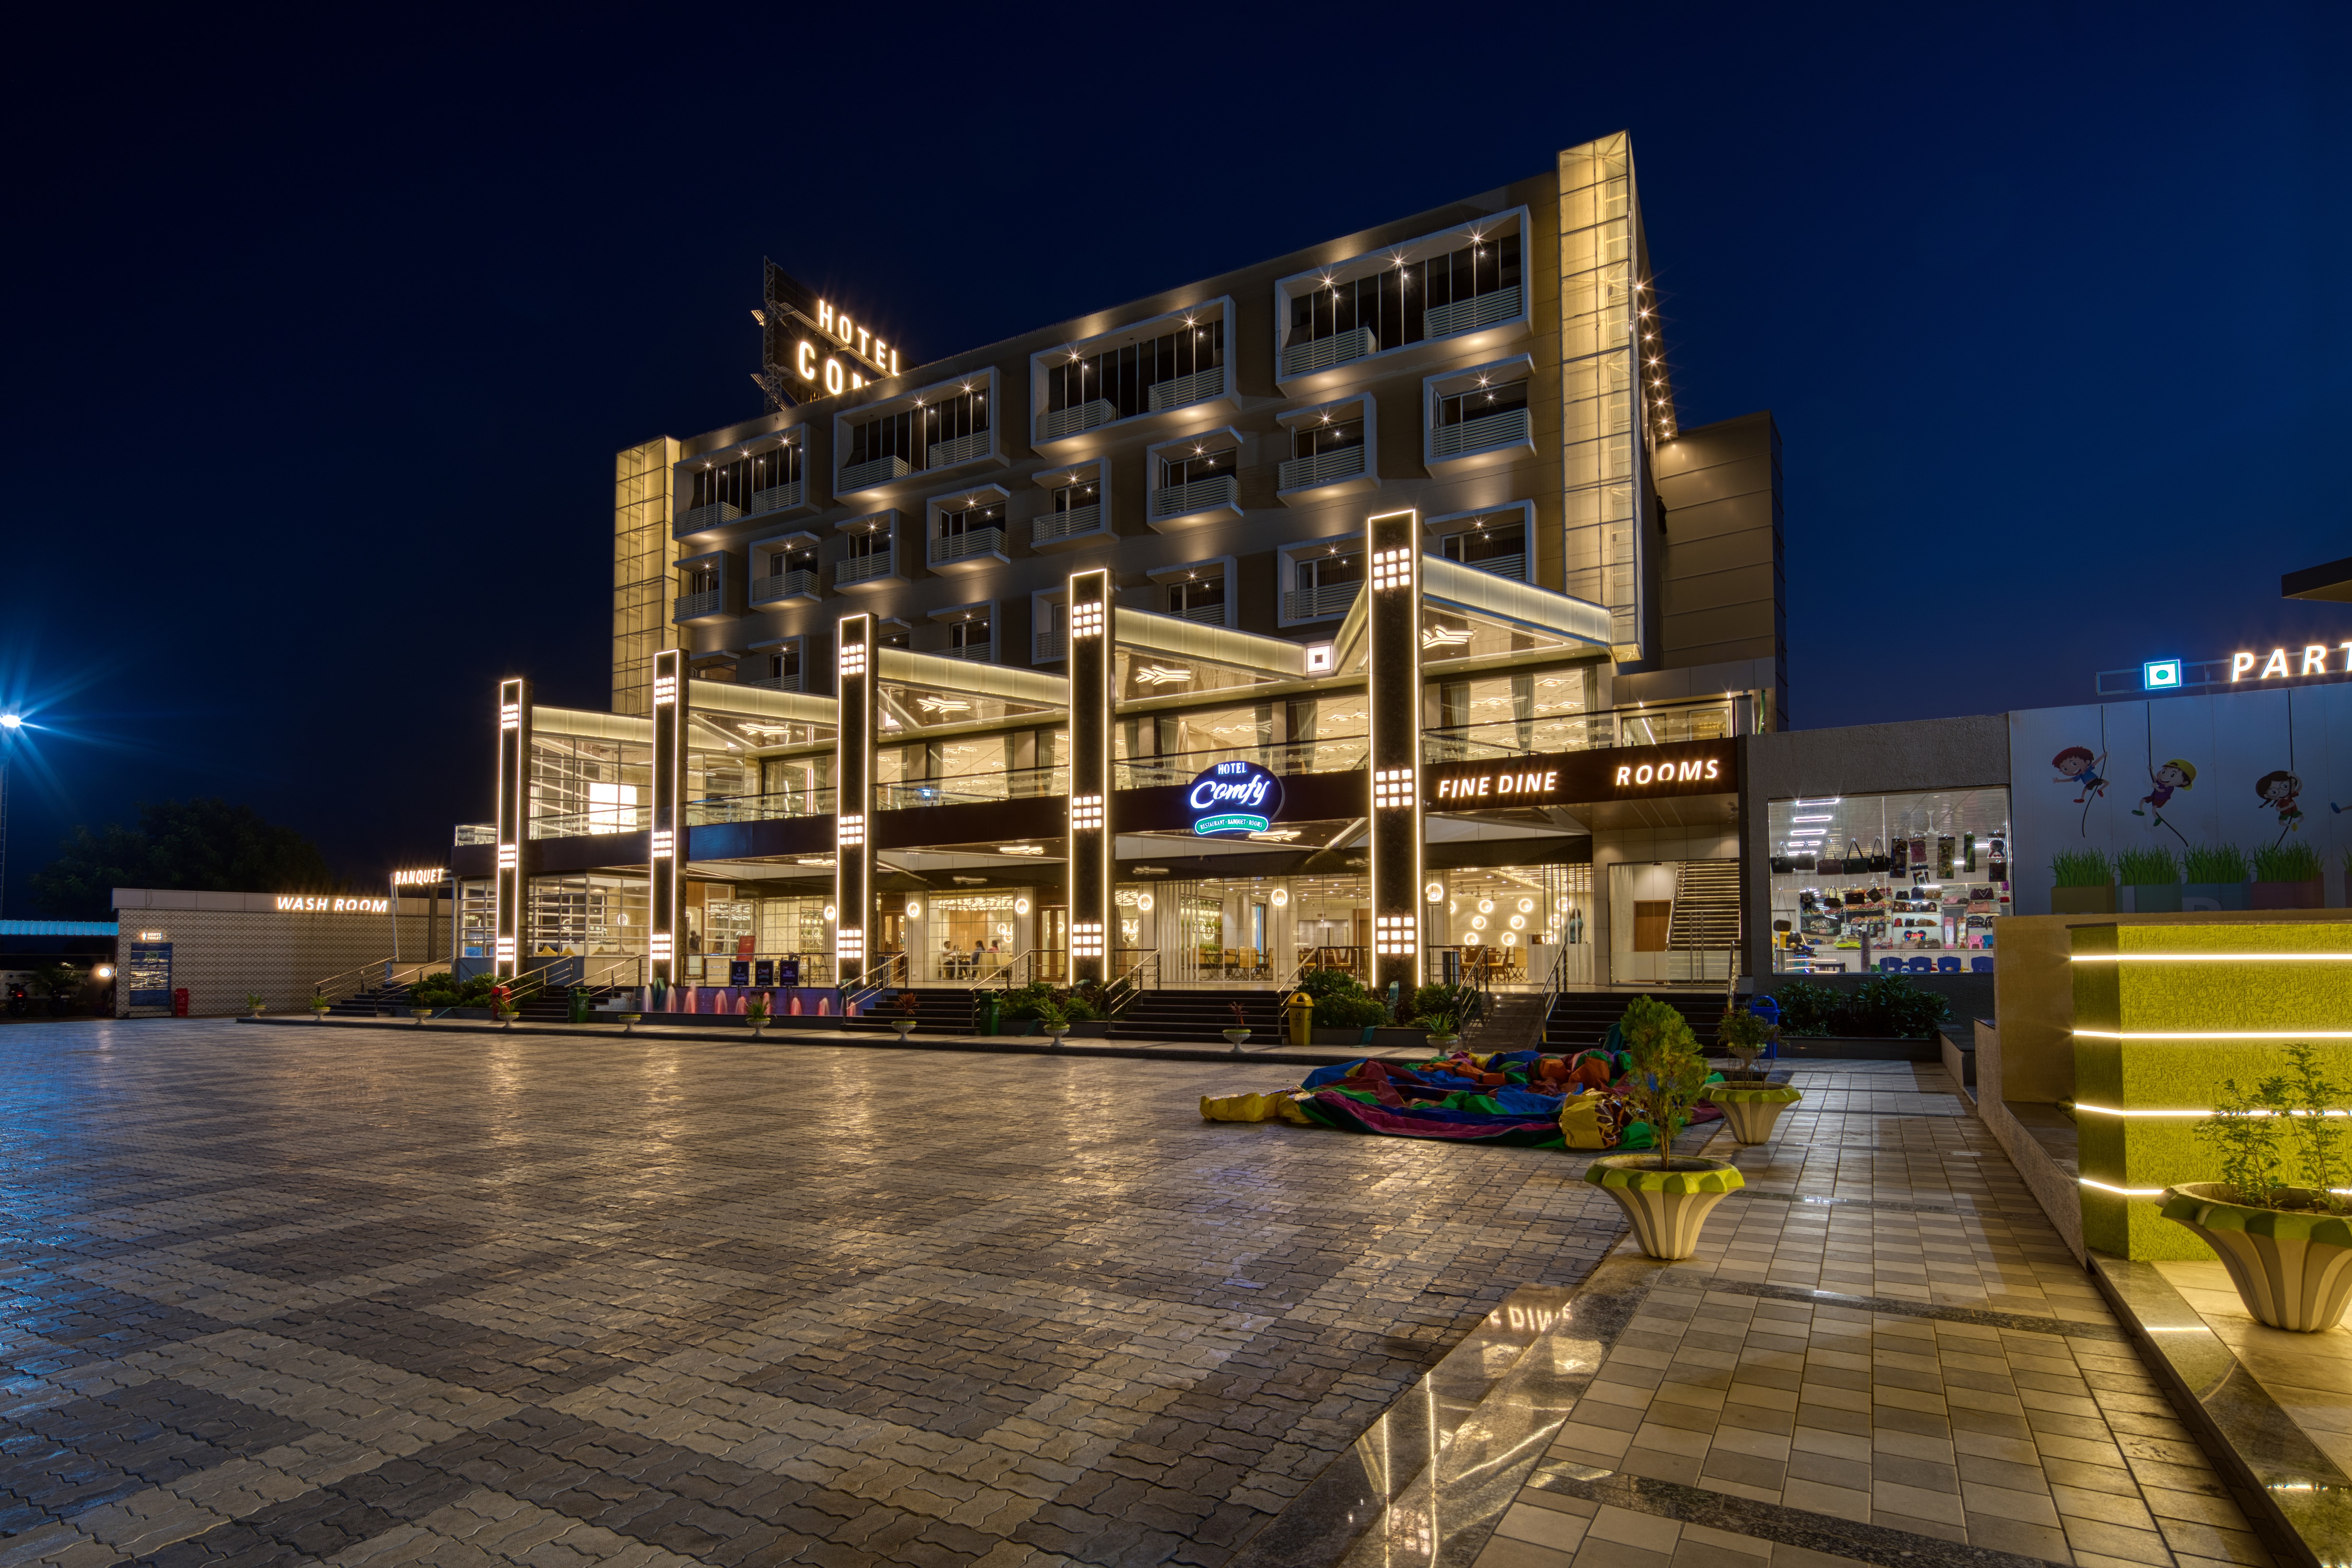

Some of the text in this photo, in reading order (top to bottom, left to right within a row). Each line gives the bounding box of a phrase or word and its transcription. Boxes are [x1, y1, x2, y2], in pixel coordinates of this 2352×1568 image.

[819, 298, 900, 376] HOTEL
[1218, 763, 1247, 775] HOTEL
[1439, 759, 1718, 798] FINE DINE ROOMS
[1190, 774, 1270, 809] Comfy
[1200, 819, 1225, 830] RESTAURANT
[1248, 819, 1263, 827] ROOMS
[394, 868, 444, 885] BANQUET
[277, 897, 388, 912] WASH ROOM
